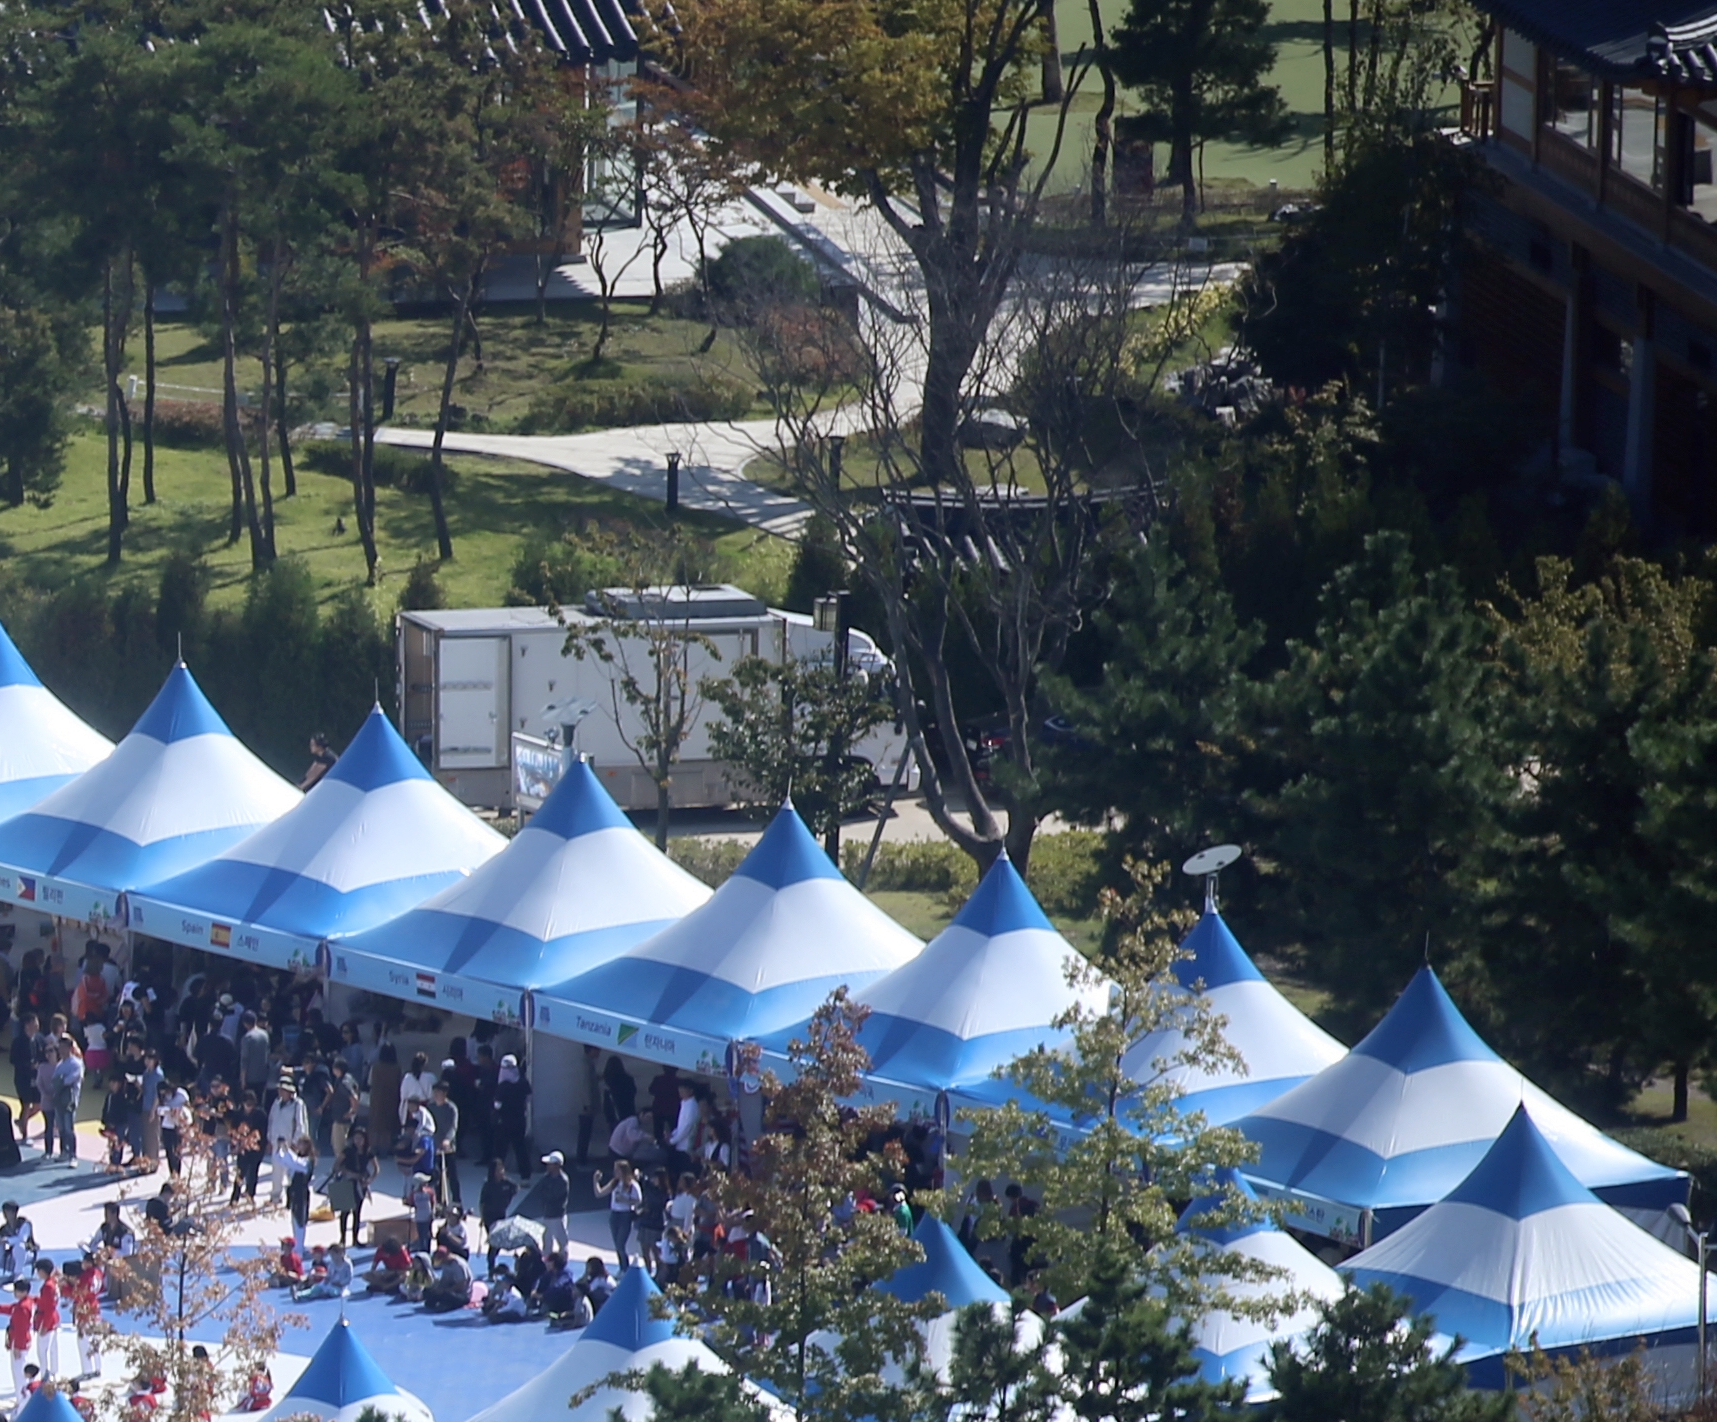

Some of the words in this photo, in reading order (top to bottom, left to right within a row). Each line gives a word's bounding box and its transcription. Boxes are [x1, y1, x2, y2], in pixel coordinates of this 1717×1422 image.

[42, 885, 64, 905] 필리핀
[181, 918, 204, 936] Spain
[237, 934, 260, 952] 스페인
[389, 969, 409, 986] Syria
[442, 984, 464, 1002] 시리아
[576, 1015, 612, 1037] Tanzania
[644, 1033, 675, 1054] 탄자니아
